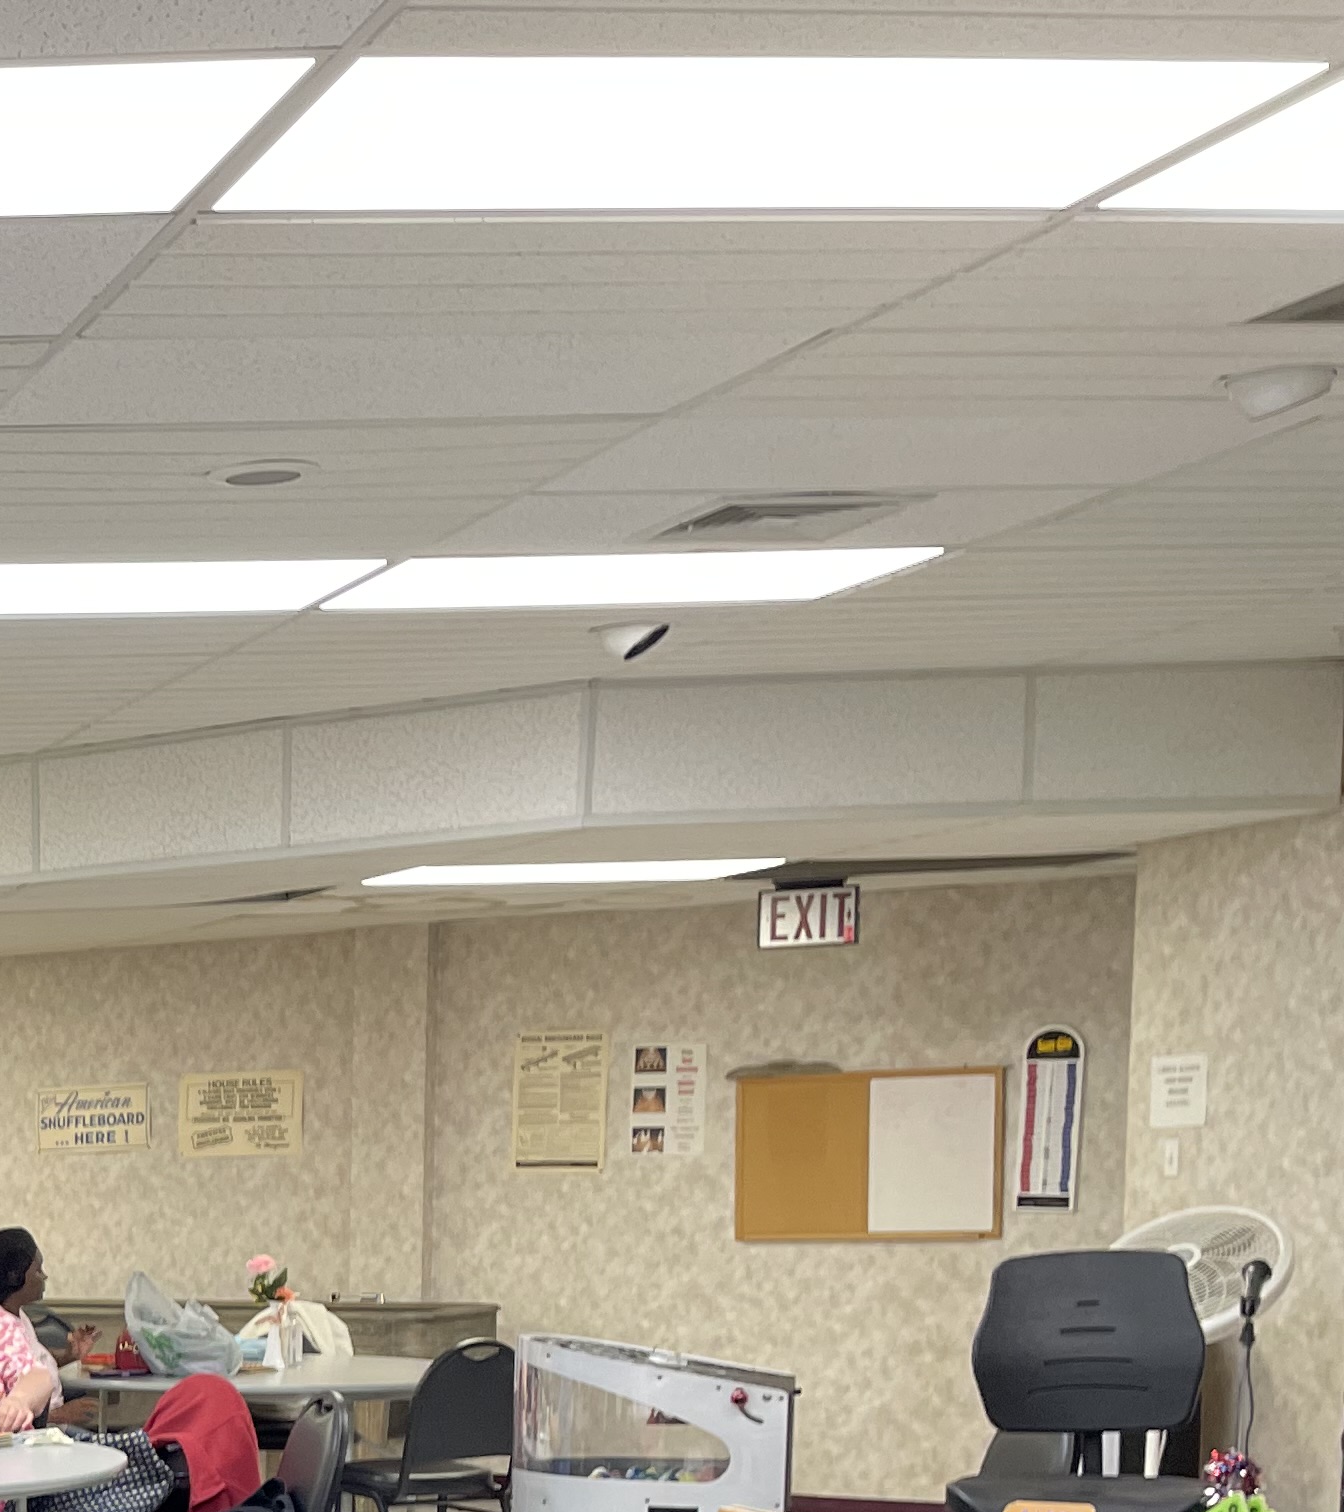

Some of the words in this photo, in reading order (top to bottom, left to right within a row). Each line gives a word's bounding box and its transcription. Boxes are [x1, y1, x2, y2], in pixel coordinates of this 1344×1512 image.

[770, 893, 852, 941] EXIT
[54, 1090, 132, 1115] American
[40, 1111, 145, 1130] SHUFFLEBOARD
[74, 1130, 117, 1145] HERE
